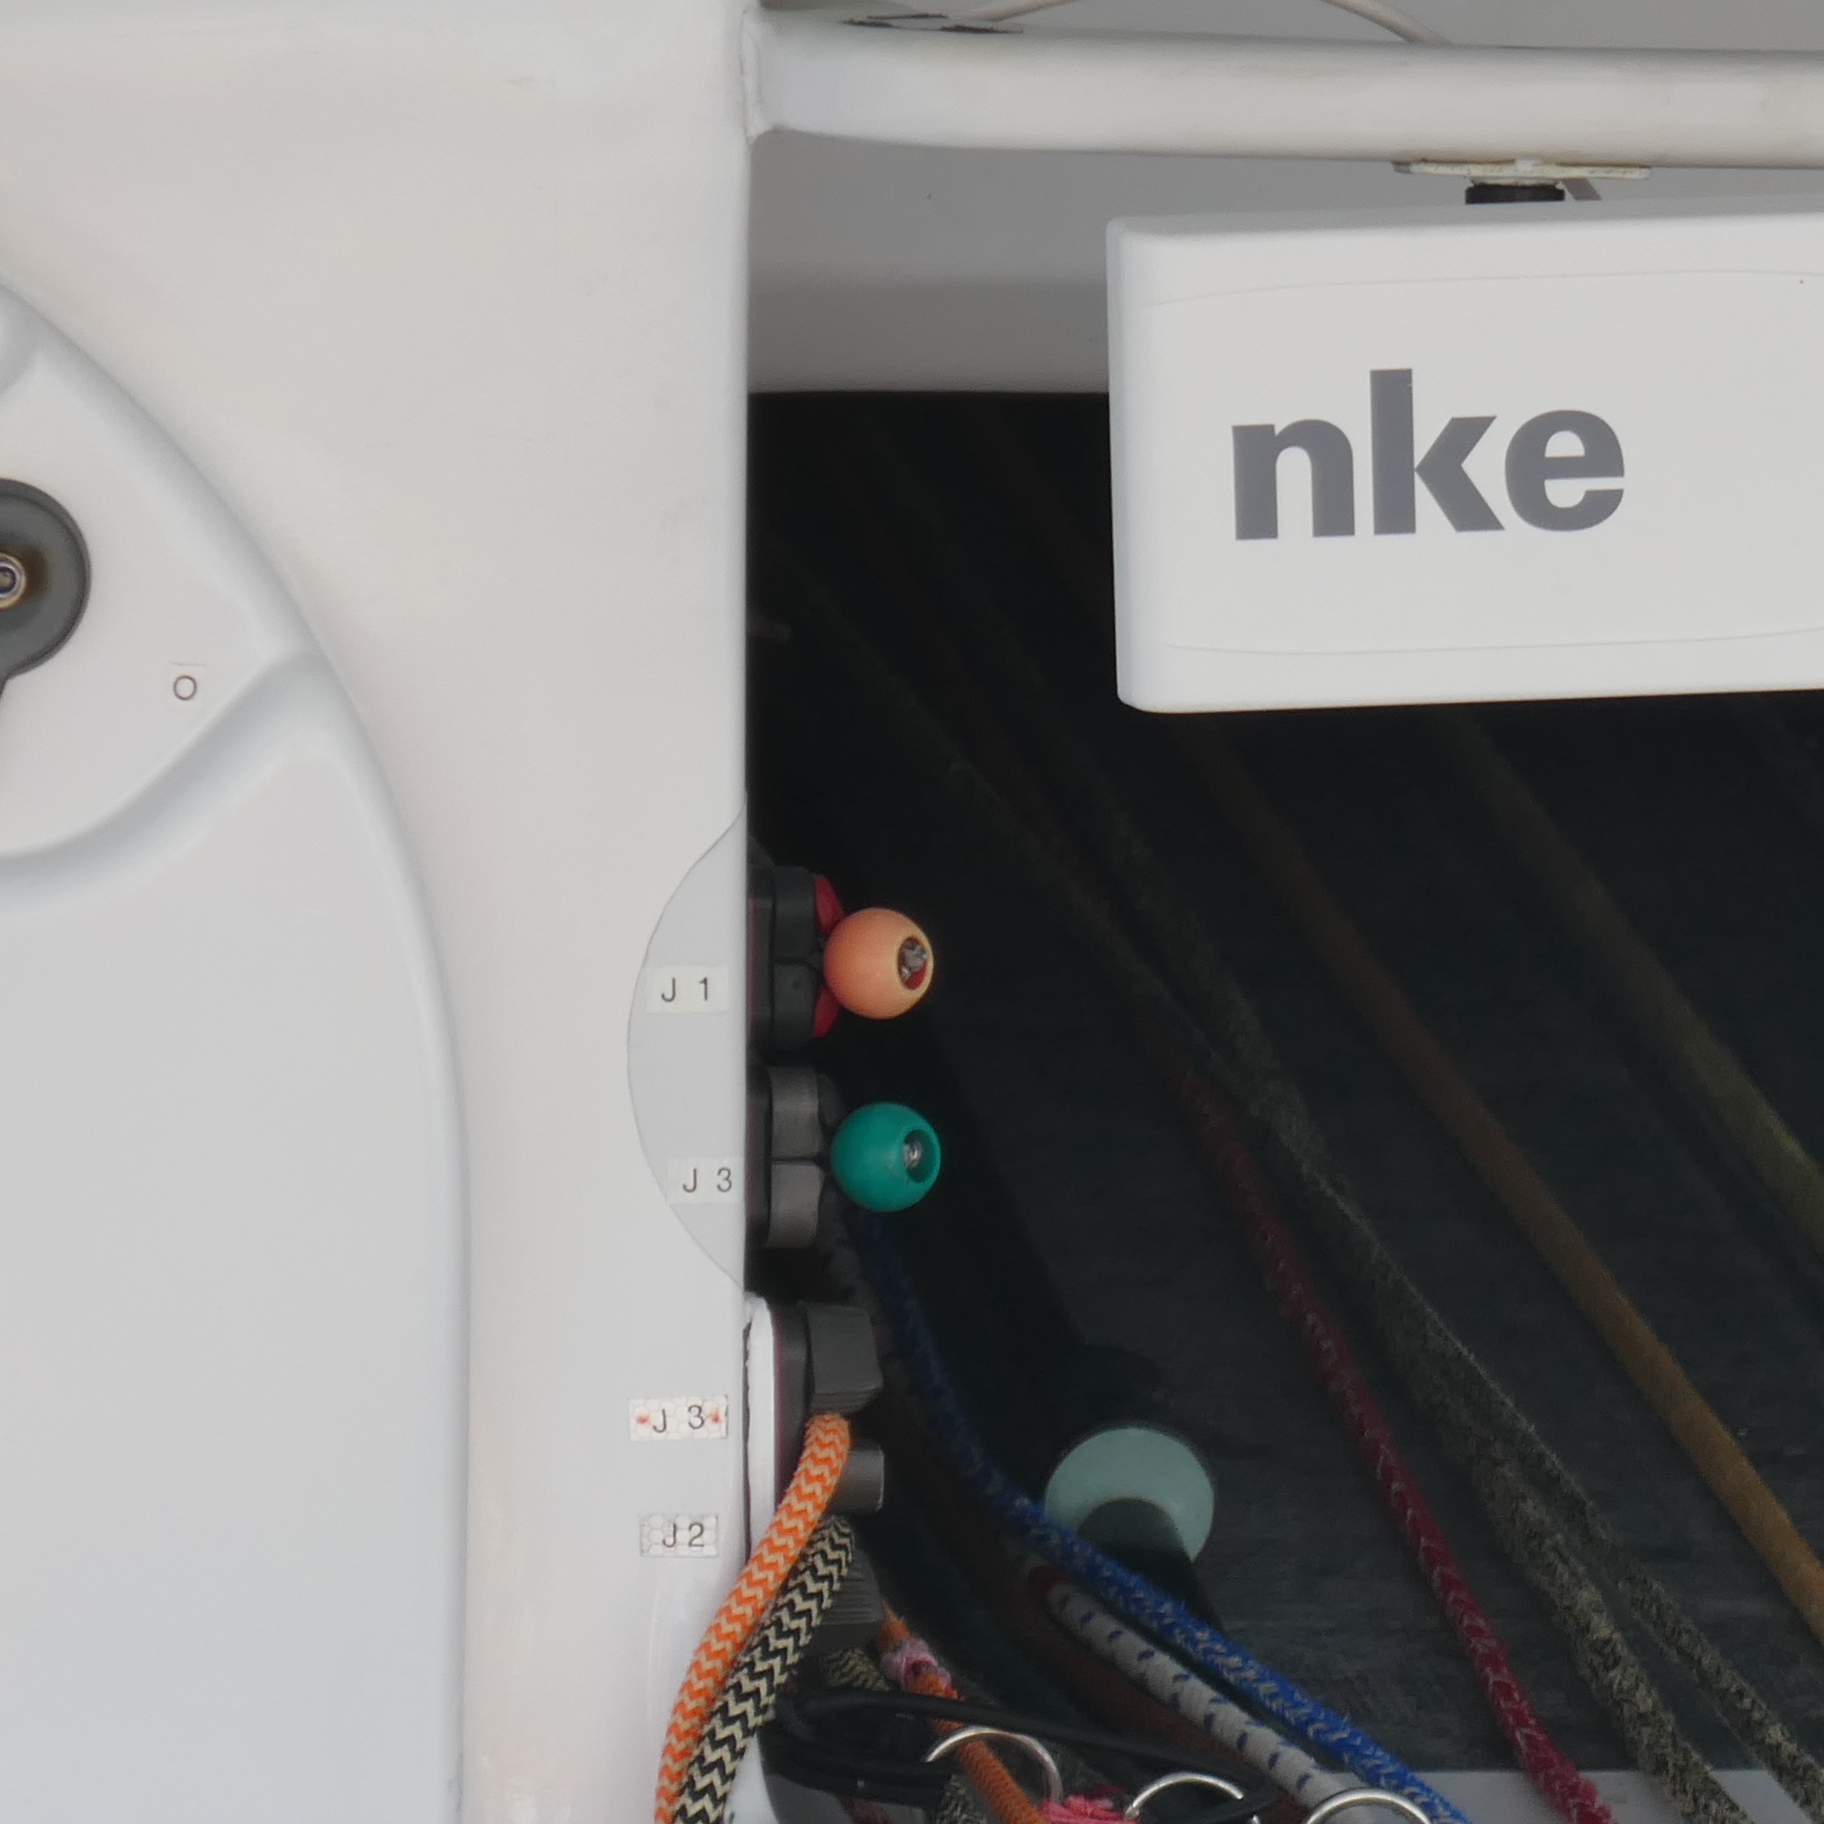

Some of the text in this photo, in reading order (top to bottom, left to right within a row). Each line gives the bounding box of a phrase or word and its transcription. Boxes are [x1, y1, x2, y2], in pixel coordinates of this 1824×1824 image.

[1231, 368, 1625, 540] nke
[661, 976, 708, 1003] J 1
[683, 1166, 732, 1193] J 3
[653, 1404, 704, 1434] J 3
